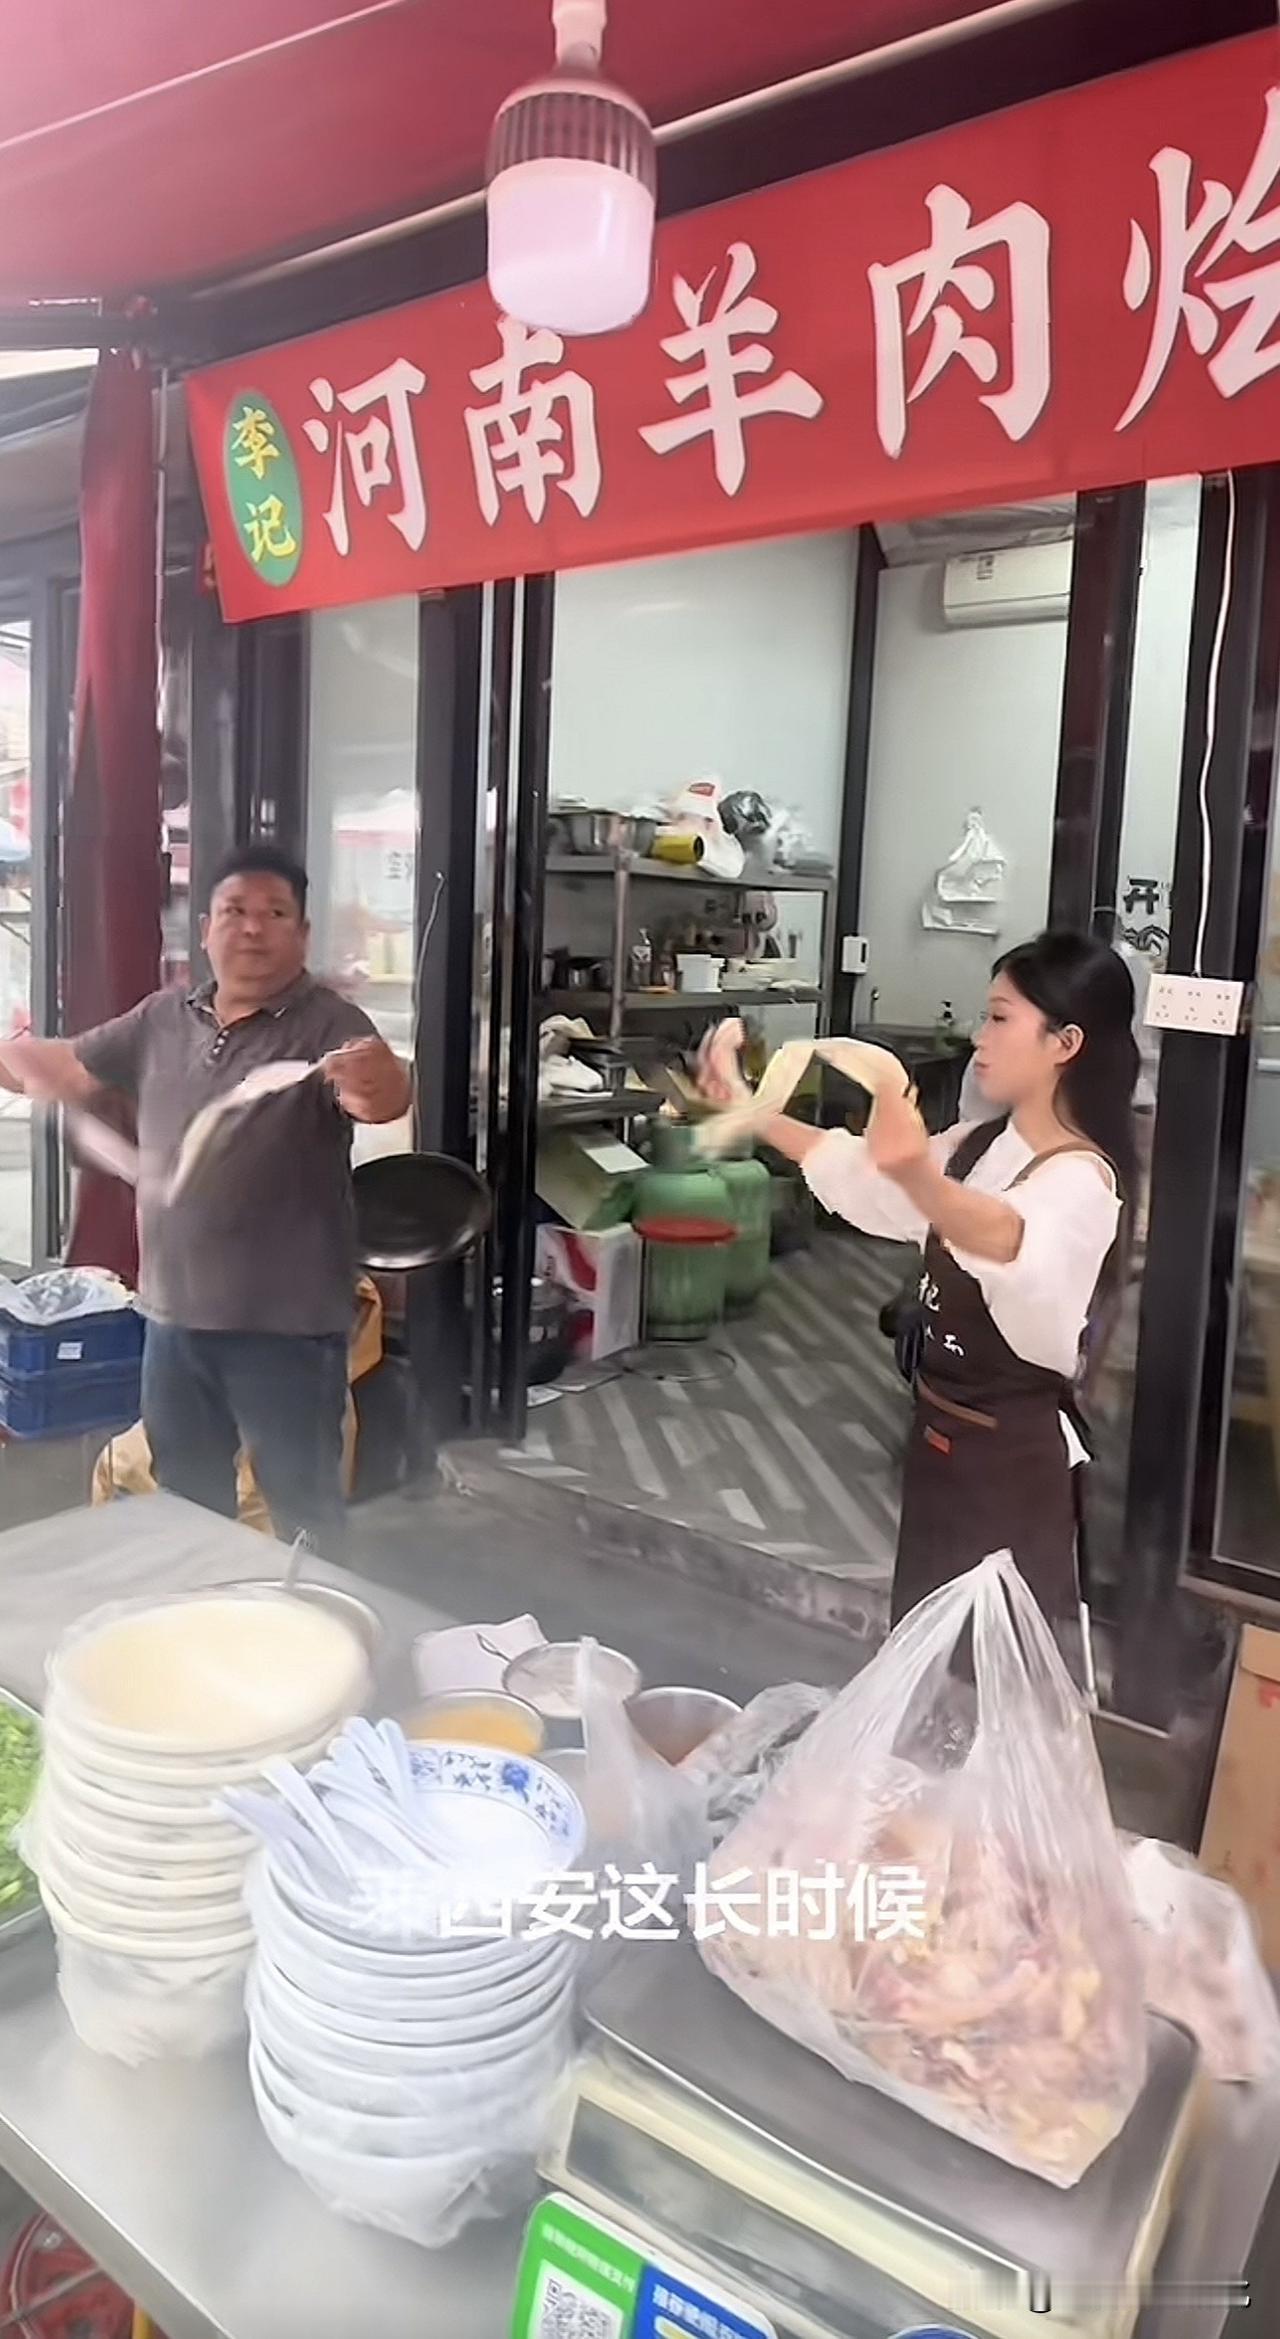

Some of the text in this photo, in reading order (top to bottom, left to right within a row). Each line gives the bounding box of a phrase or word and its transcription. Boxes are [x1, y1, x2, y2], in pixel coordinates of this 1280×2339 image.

[302, 86, 1280, 557] 河南羊肉烩
[231, 406, 297, 563] 李记
